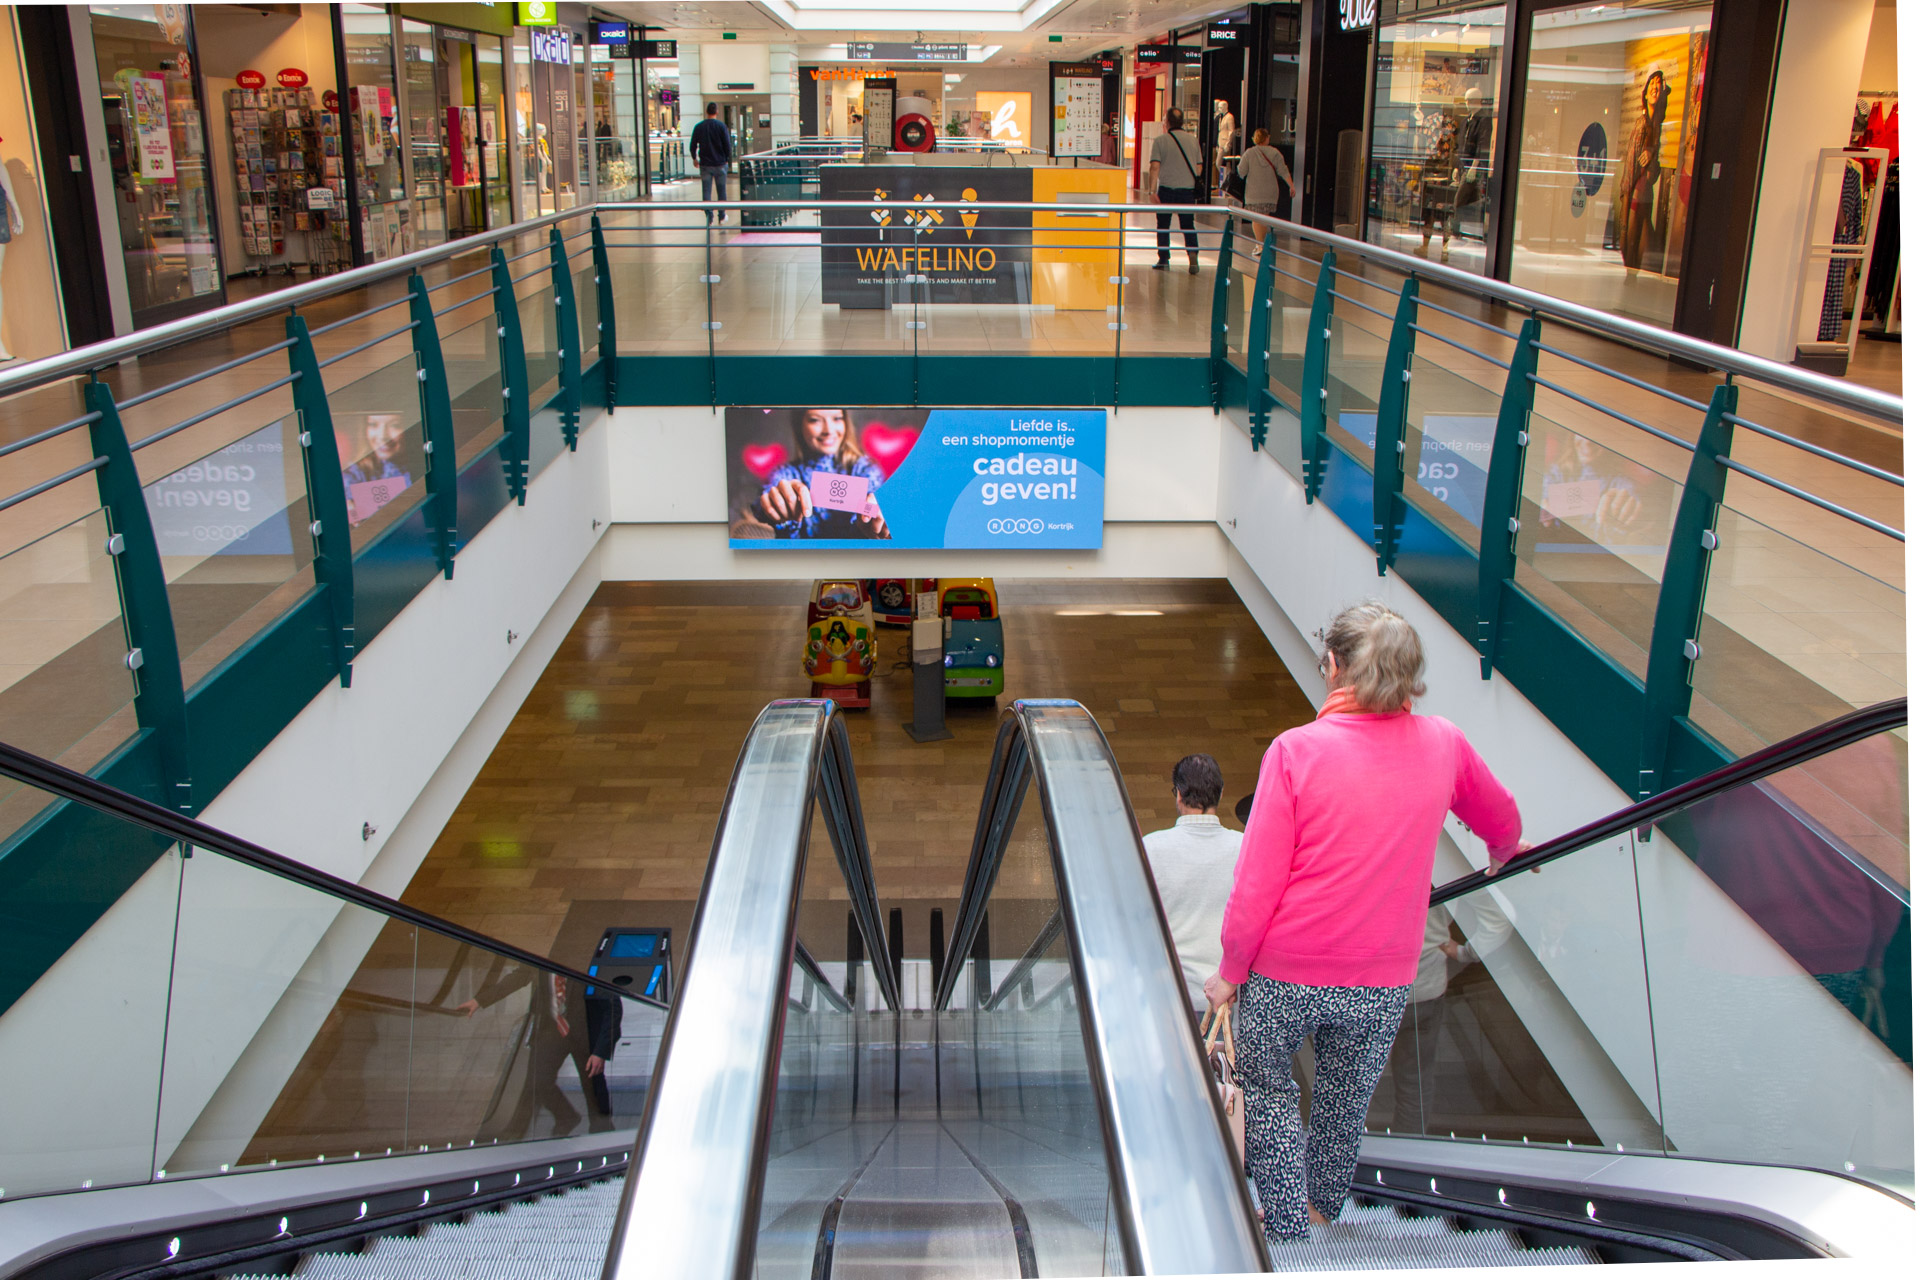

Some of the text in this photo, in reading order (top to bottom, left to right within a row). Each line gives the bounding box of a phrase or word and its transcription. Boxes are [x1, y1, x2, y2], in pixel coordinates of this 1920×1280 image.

[1210, 31, 1237, 40] BRICE
[809, 67, 896, 81] vanHaren
[856, 247, 996, 271] WAFELINO
[1010, 419, 1075, 432] Liefde is..
[942, 434, 1075, 449] een shopmomentje
[973, 452, 1077, 476] cadeau
[981, 477, 1077, 506] geven!
[1048, 523, 1074, 531] Kortrijk
